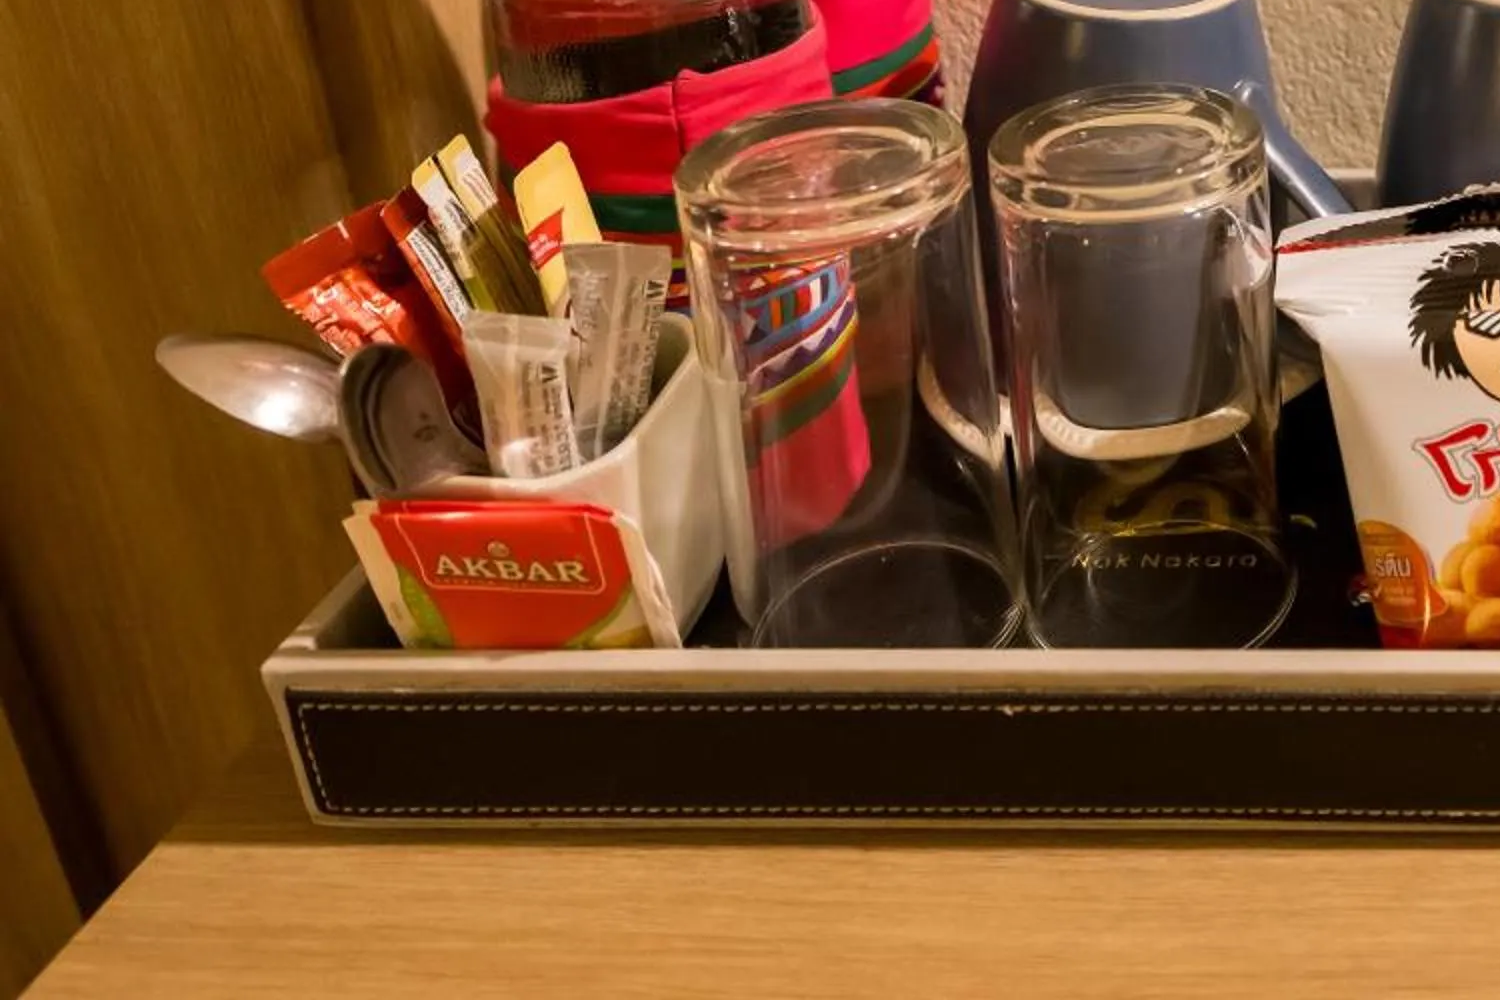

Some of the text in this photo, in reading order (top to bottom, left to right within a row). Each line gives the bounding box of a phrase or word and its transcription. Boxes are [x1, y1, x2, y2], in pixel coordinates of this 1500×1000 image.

[435, 553, 590, 583] AKBAR
[1071, 552, 1258, 570] Nak Nakara
